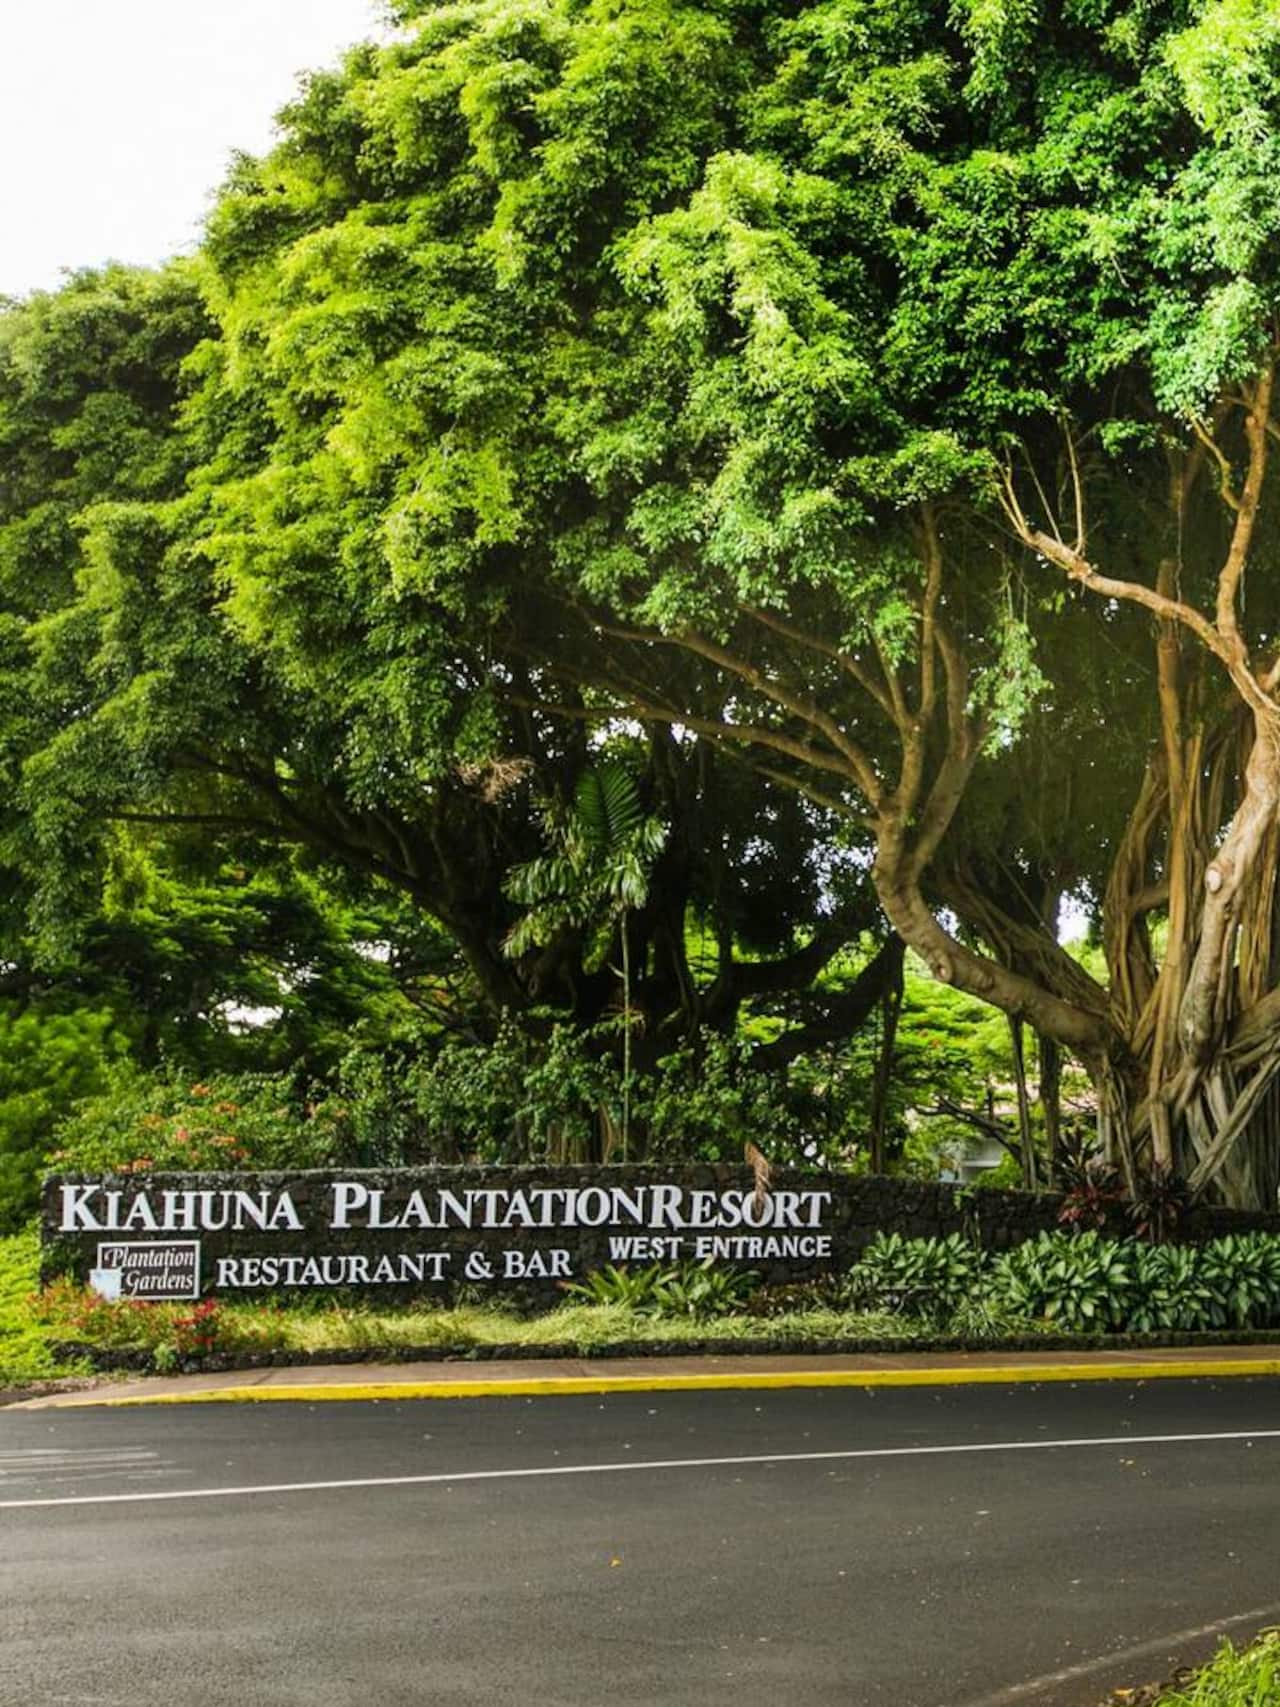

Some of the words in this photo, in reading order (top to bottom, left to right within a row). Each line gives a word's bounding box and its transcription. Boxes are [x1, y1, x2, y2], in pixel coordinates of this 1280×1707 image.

[58, 1184, 304, 1232] KIAHUNA
[104, 1246, 194, 1268] Plantation
[609, 1236, 684, 1260] WEST
[695, 1235, 832, 1259] ENTRANCE
[125, 1267, 193, 1296] Gardens
[216, 1252, 451, 1287] RESTAURANT
[464, 1251, 494, 1279] &
[502, 1249, 573, 1278] BAR
